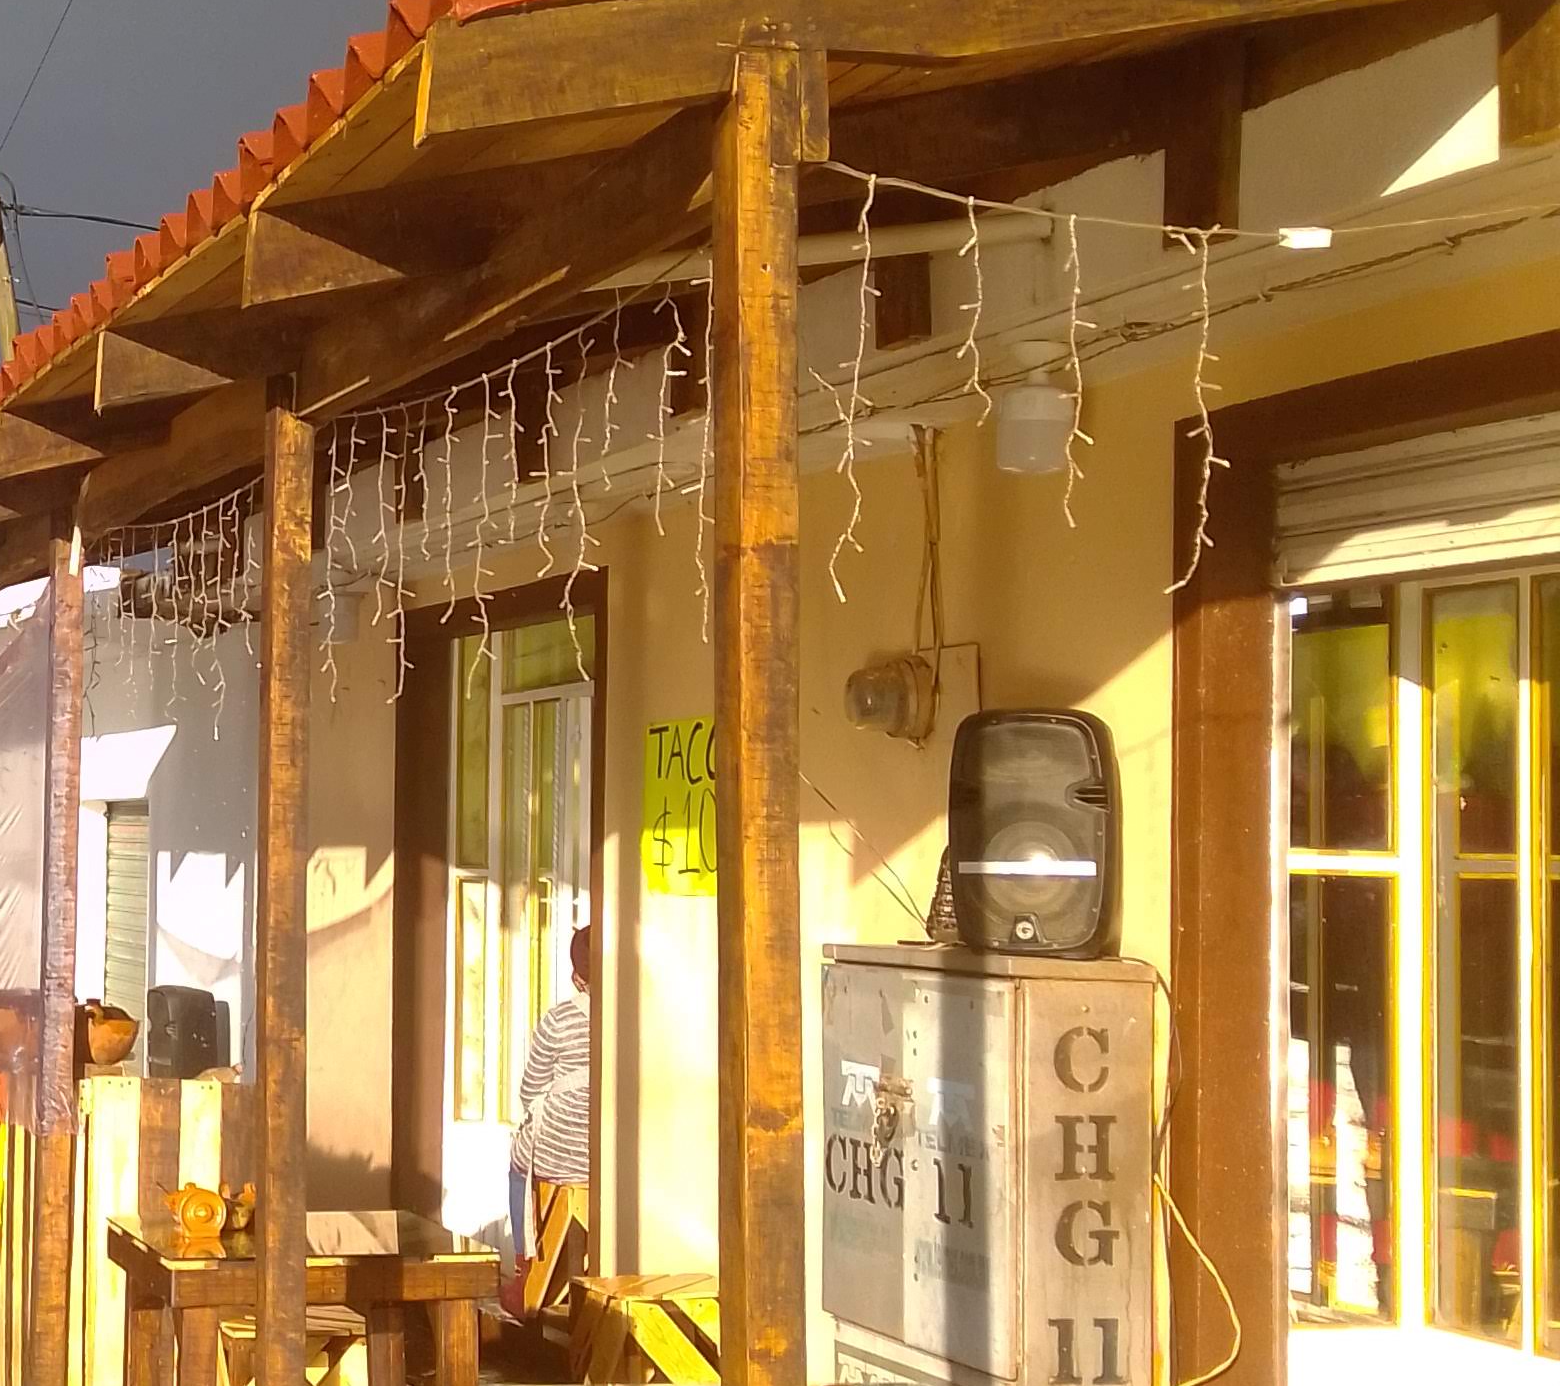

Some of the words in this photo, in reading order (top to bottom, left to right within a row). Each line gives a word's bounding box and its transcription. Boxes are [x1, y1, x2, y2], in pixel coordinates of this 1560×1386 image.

[652, 788, 717, 878] $10
[824, 1134, 904, 1211] CHG
[933, 1157, 974, 1229] 11
[1048, 1317, 1130, 1385] 11
